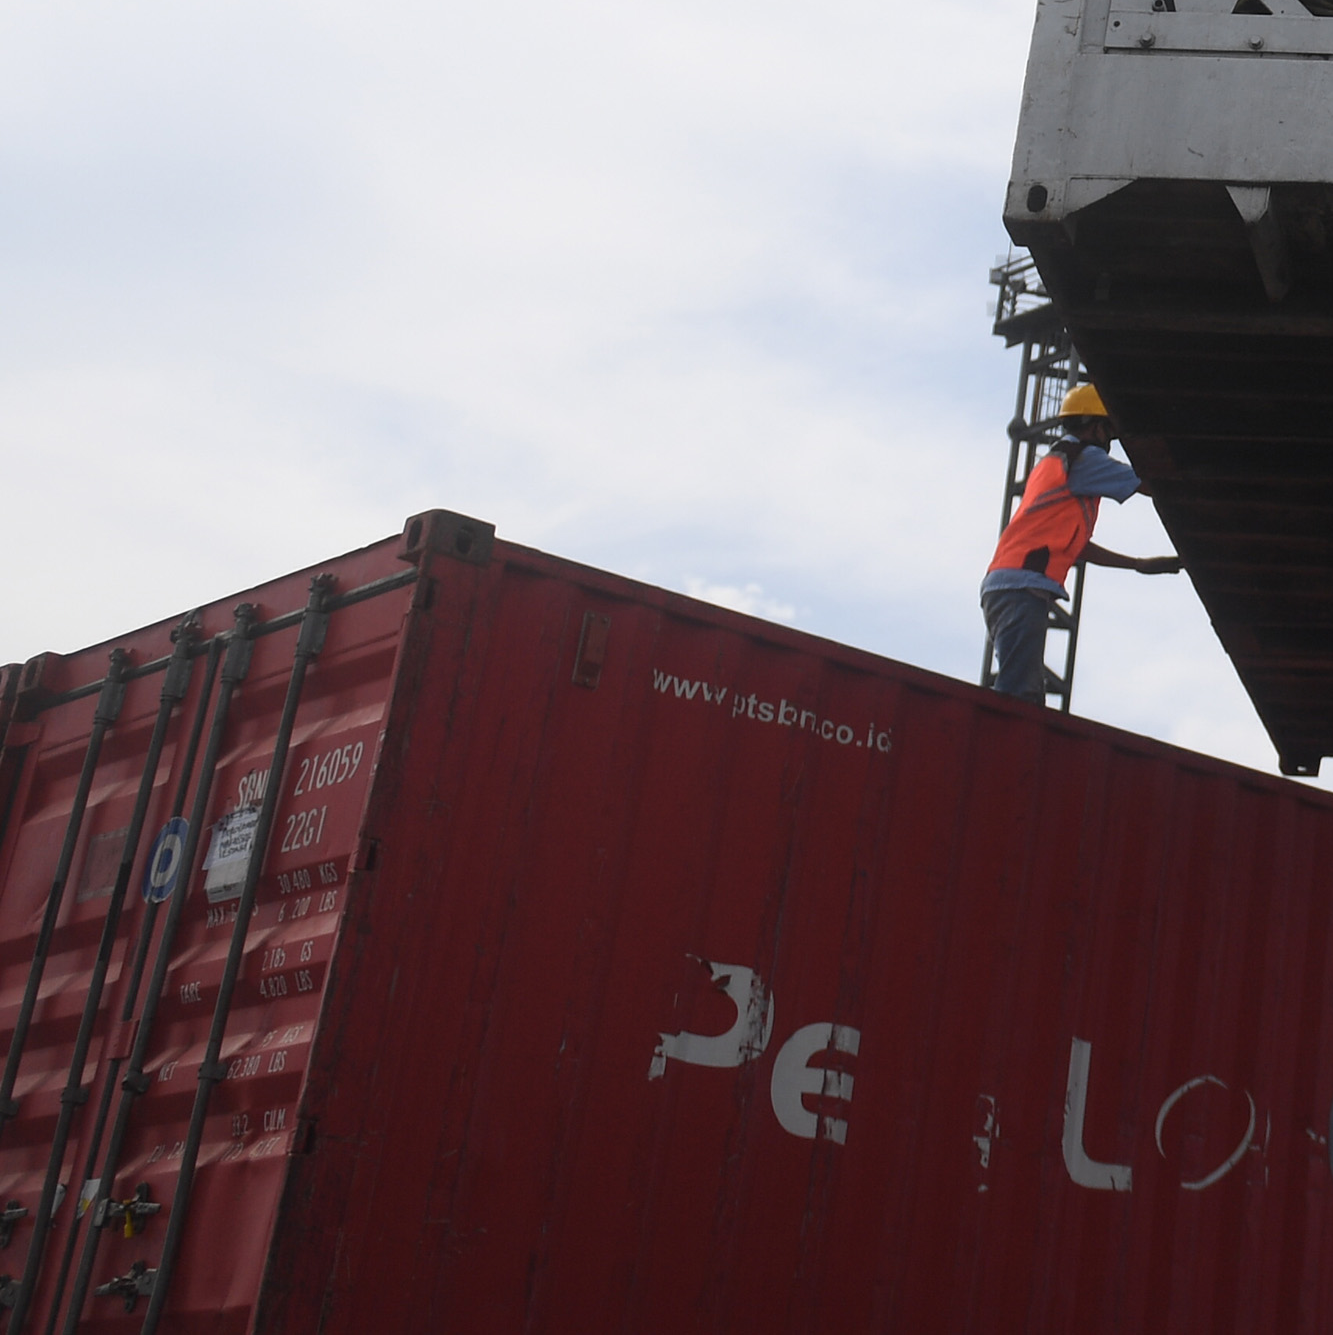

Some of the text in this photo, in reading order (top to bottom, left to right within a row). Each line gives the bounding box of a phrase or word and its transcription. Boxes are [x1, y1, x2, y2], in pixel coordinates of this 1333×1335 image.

[294, 741, 364, 797] 216059
[281, 805, 328, 854] 22G1
[319, 862, 339, 885] KGS
[318, 890, 338, 914] LBS
[180, 980, 202, 1005] TARE
[294, 969, 313, 993] LBS
[158, 1061, 179, 1083] NET
[267, 1050, 288, 1074] LBS
